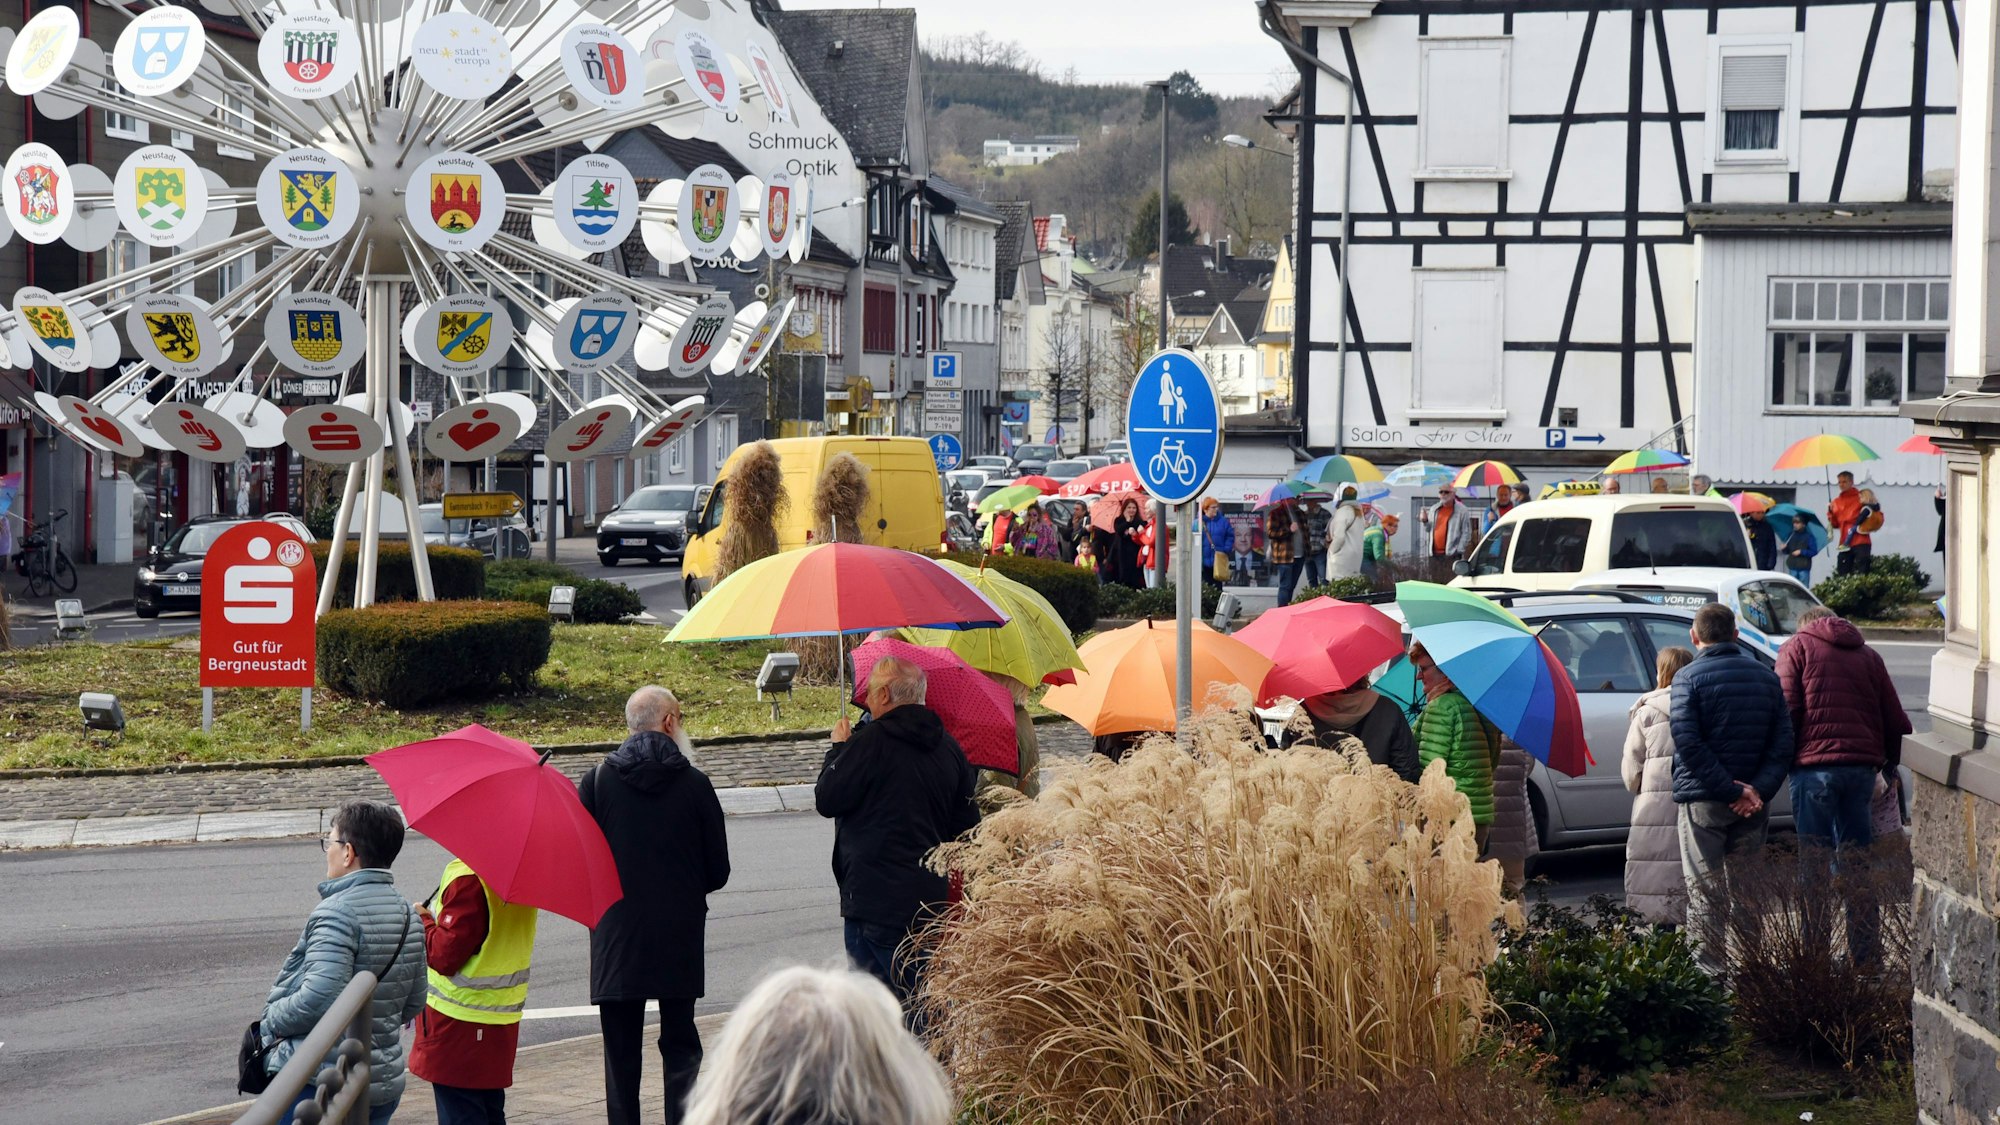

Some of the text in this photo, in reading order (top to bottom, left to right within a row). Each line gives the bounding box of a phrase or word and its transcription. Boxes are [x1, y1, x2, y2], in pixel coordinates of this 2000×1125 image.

[294, 15, 331, 24] Neustadt
[580, 29, 611, 39] Neustadt
[419, 46, 438, 55] neu
[455, 46, 480, 56] stadt
[455, 57, 490, 68] europa
[749, 131, 838, 150] Schmuck
[22, 149, 49, 160] Neustadt
[142, 152, 177, 163] Neustadt
[288, 154, 327, 164] Neustadt
[438, 158, 475, 169] Neustadt
[585, 160, 610, 170] Titisee
[786, 158, 838, 178] Optik
[700, 171, 724, 182] Neustadt
[150, 232, 175, 241] Vogtland
[288, 232, 330, 243] am Rennsteig
[583, 238, 607, 247] Neustadt
[24, 293, 49, 301] Neustadt
[294, 296, 331, 306] Neustadt
[593, 297, 622, 306] Neustadt
[146, 298, 180, 308] Neustadt
[450, 299, 486, 308] Neustadt
[938, 358, 950, 375] P
[283, 382, 330, 394] DÖNER FACTORY
[1351, 428, 1513, 448] Salon For Men
[1550, 431, 1563, 446] P
[1100, 480, 1132, 492] SPD
[1664, 595, 1685, 604] VOR
[1686, 596, 1707, 605] ORT
[233, 640, 283, 654] Gut für
[208, 657, 307, 674] Bergneustadt
